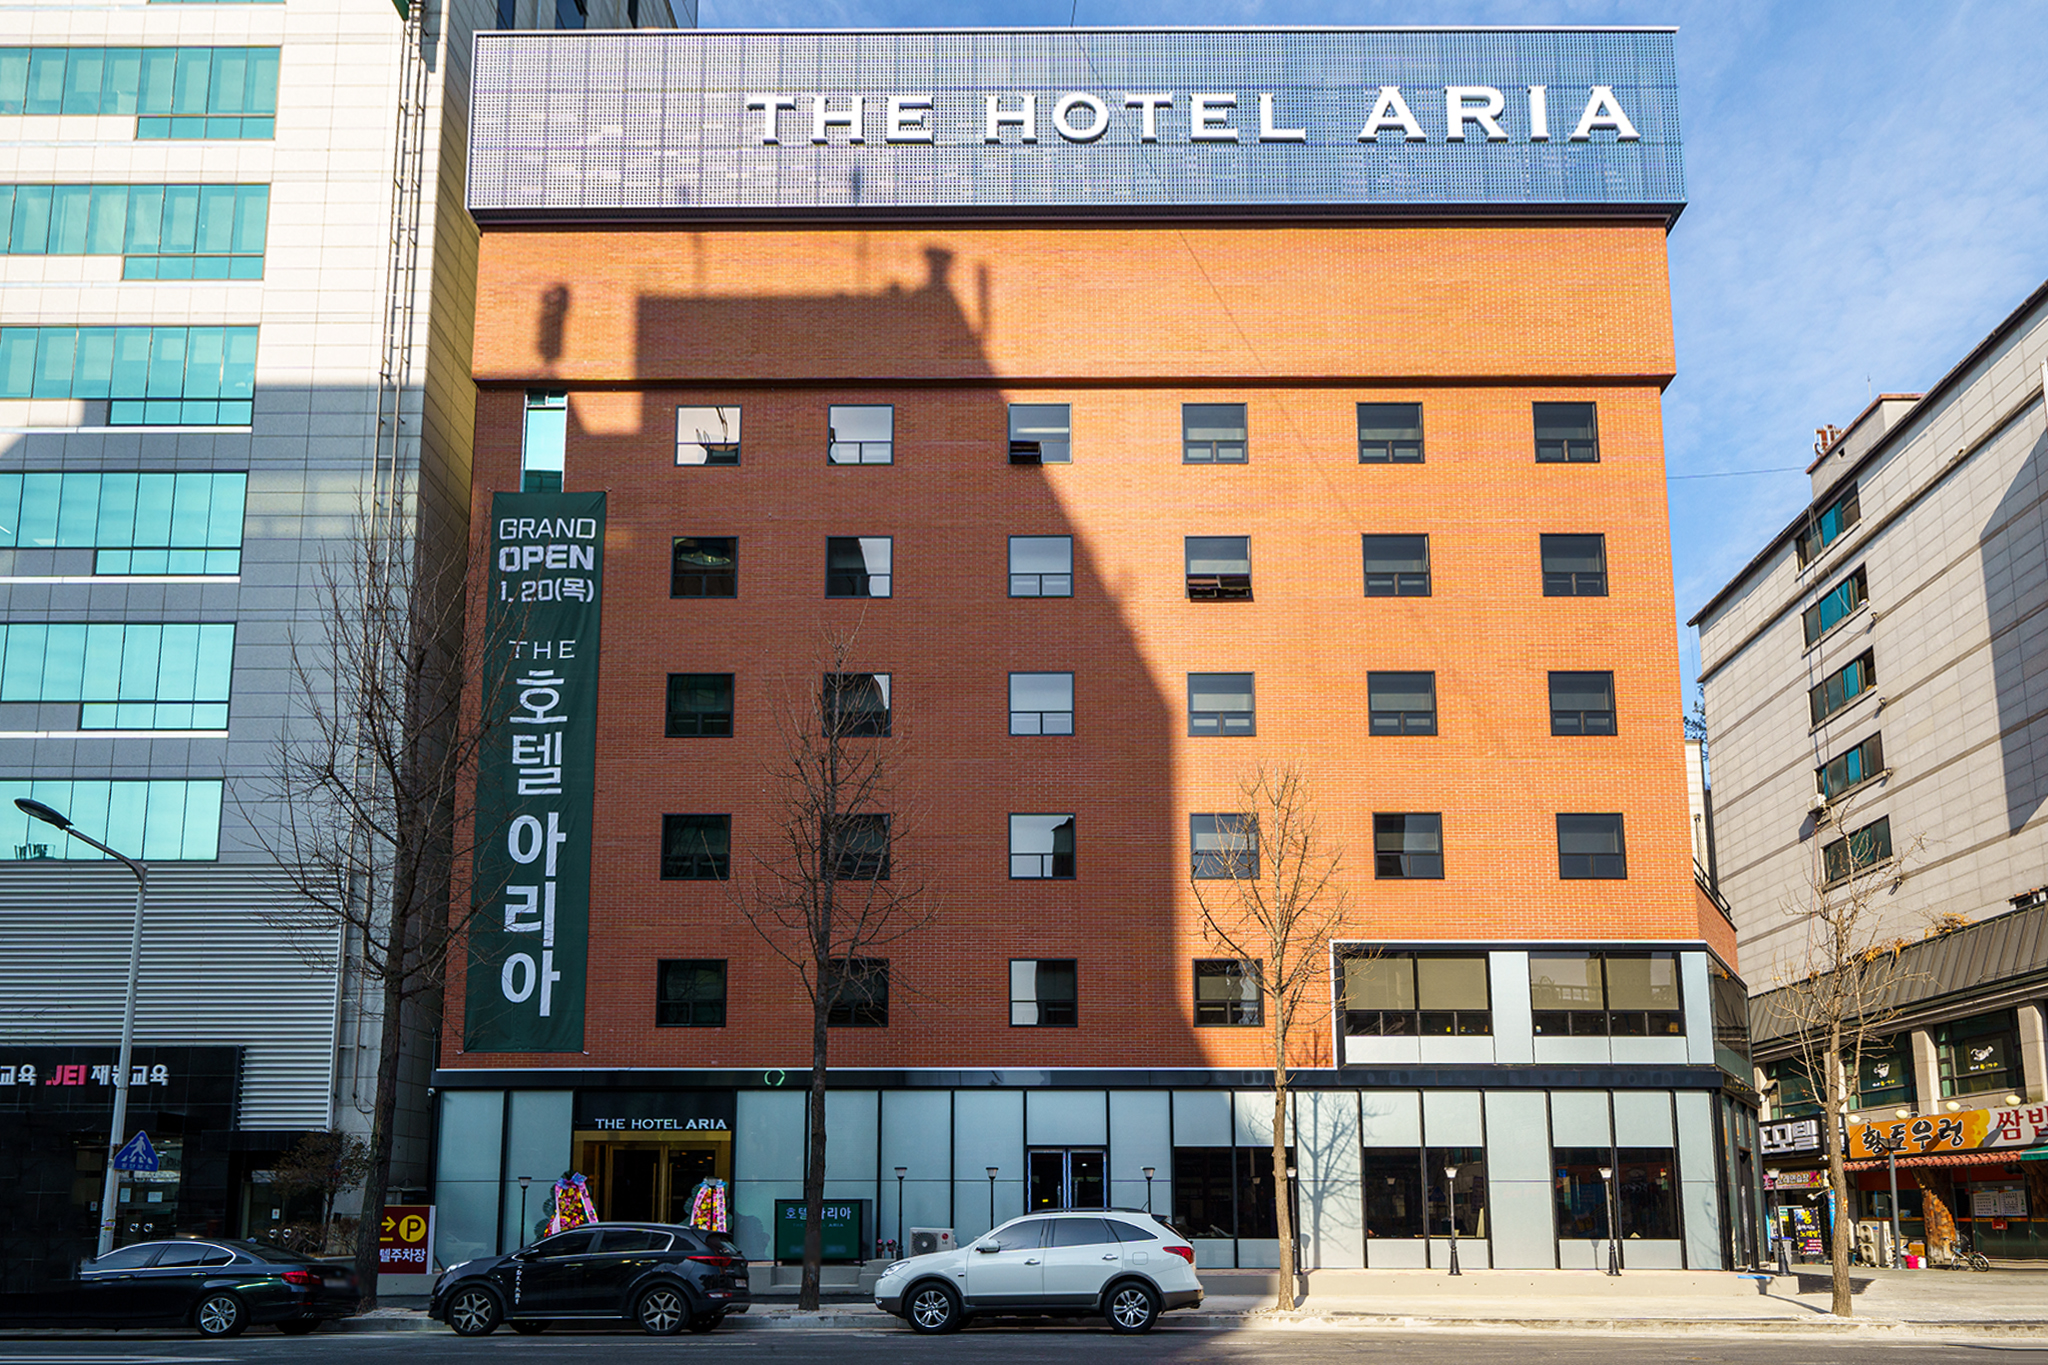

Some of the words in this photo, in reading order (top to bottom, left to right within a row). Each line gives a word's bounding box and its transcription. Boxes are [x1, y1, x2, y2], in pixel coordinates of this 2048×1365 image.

[746, 93, 934, 144] THE
[984, 92, 1306, 144] HOTEL
[1358, 85, 1641, 143] ARIA
[499, 517, 597, 540] GRAND
[498, 544, 595, 572] OPEN
[508, 640, 577, 660] THE
[595, 1118, 625, 1130] THE
[631, 1118, 683, 1130] HOTEL
[685, 1118, 727, 1130] ARIA
